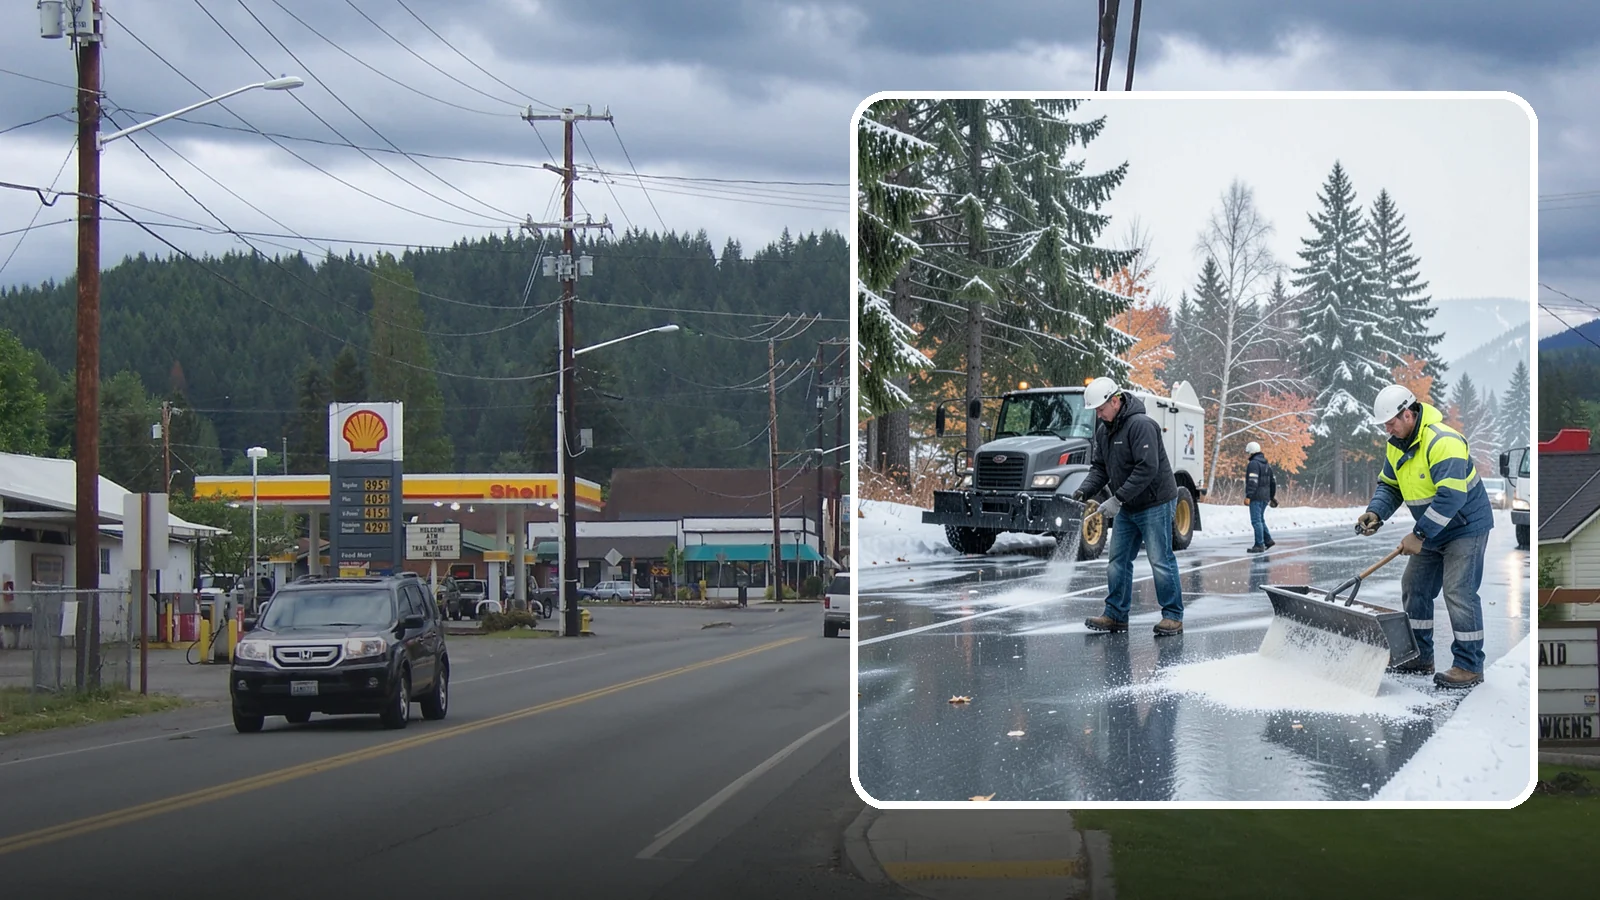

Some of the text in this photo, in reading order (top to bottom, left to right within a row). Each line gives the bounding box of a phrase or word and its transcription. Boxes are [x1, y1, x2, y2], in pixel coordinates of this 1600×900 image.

[366, 479, 383, 490] 395
[489, 484, 547, 499] Shell
[366, 494, 383, 504] 405
[366, 507, 383, 518] 415
[366, 522, 383, 533] 429
